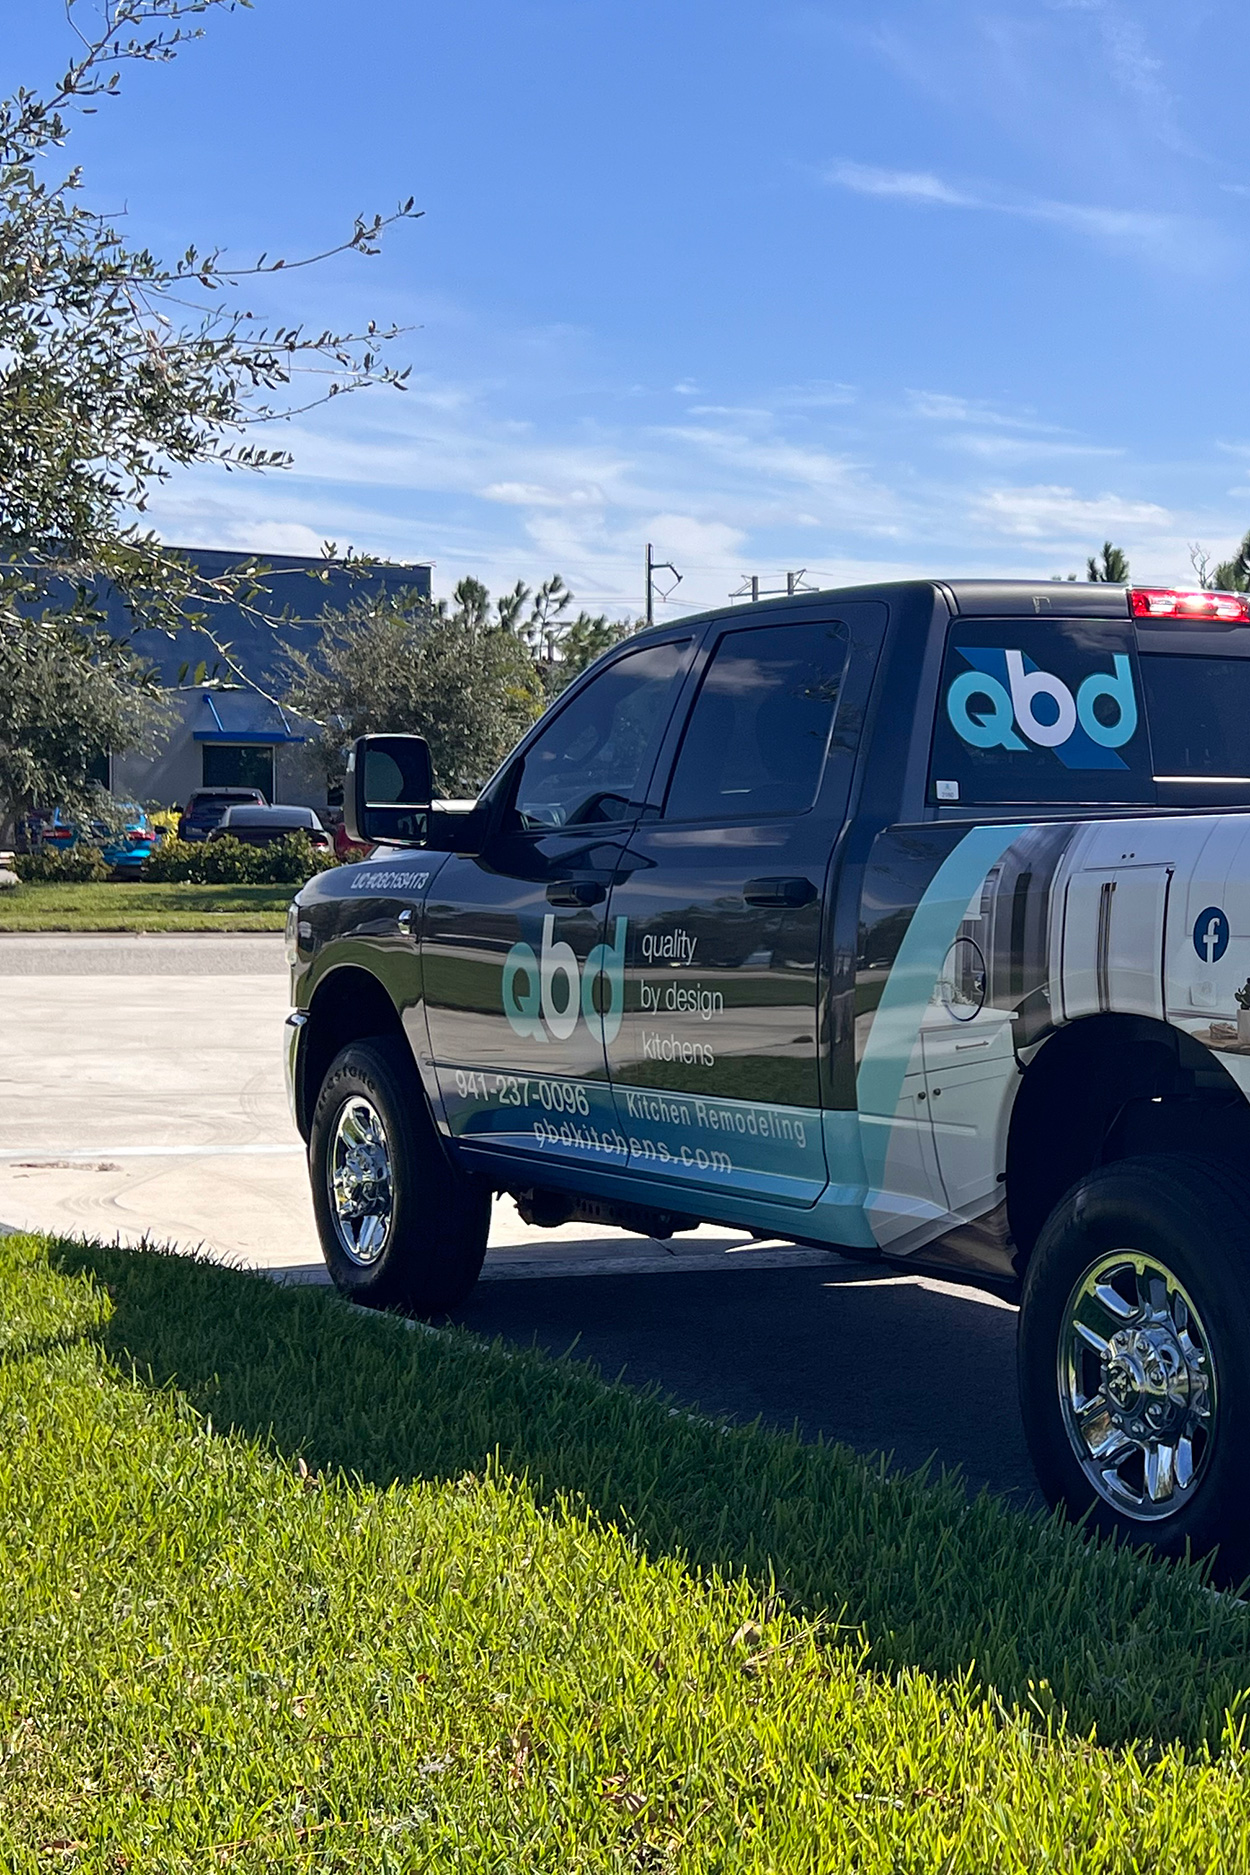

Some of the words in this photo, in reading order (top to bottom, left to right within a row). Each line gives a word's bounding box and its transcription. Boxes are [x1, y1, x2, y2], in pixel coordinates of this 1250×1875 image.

[642, 928, 698, 966] quality
[640, 979, 662, 1010] by
[665, 981, 724, 1020] design
[642, 1033, 715, 1067] kitchens
[455, 1069, 591, 1116] 941-237-0096
[627, 1092, 691, 1128] Kitchen
[697, 1098, 807, 1148] Remodeling
[534, 1119, 733, 1174] qbdkitchens.com
